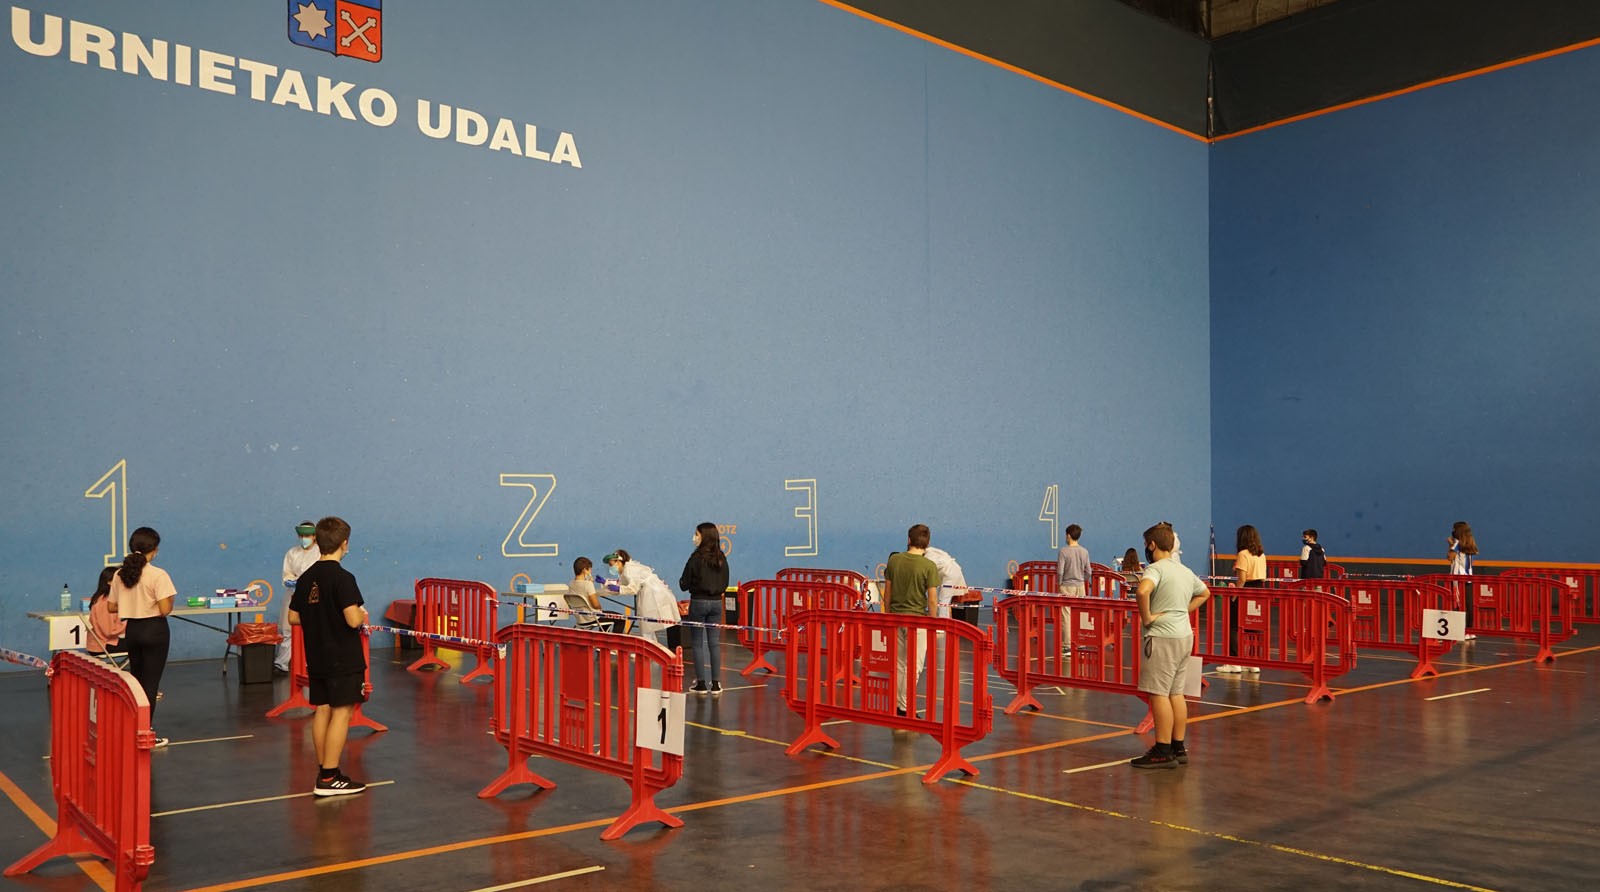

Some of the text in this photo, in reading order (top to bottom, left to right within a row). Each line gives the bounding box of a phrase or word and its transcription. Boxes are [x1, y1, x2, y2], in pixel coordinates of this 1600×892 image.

[10, 7, 582, 169] URNIETAKO UDALA
[85, 459, 127, 566] 1
[1039, 484, 1058, 549] 4
[716, 524, 737, 535] OTZ
[866, 589, 872, 602] 3
[548, 601, 558, 617] 2
[70, 624, 80, 645] 1
[1437, 617, 1449, 636] 3
[657, 707, 667, 745] 1
